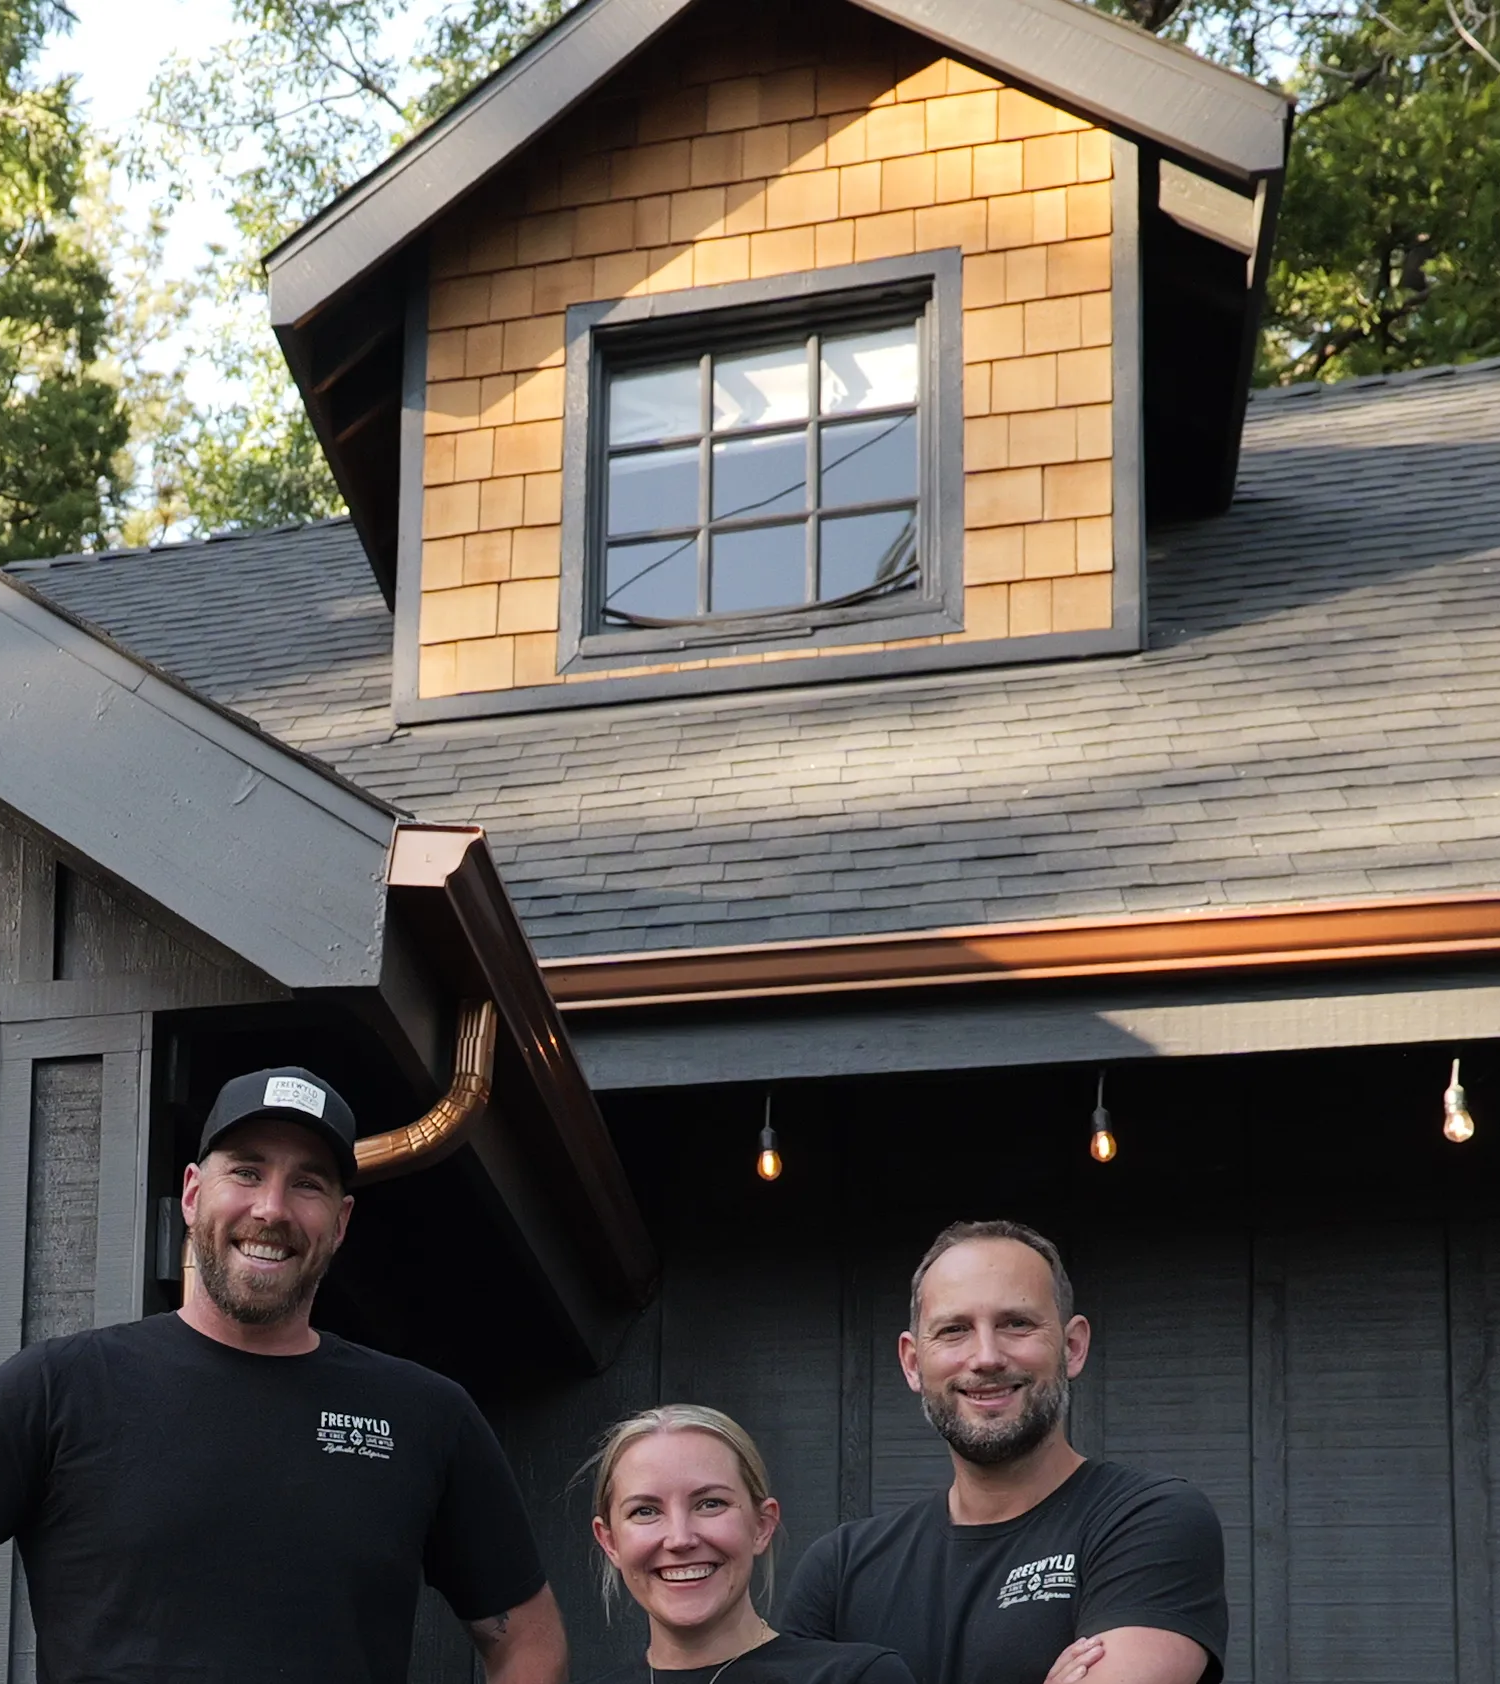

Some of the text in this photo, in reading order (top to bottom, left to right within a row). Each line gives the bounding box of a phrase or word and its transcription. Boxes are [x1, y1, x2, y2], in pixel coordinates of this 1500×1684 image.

[275, 1081, 318, 1099] FREEWYLD
[321, 1411, 390, 1436] FREEWYLD
[1006, 1553, 1075, 1585] FREEWYLD
